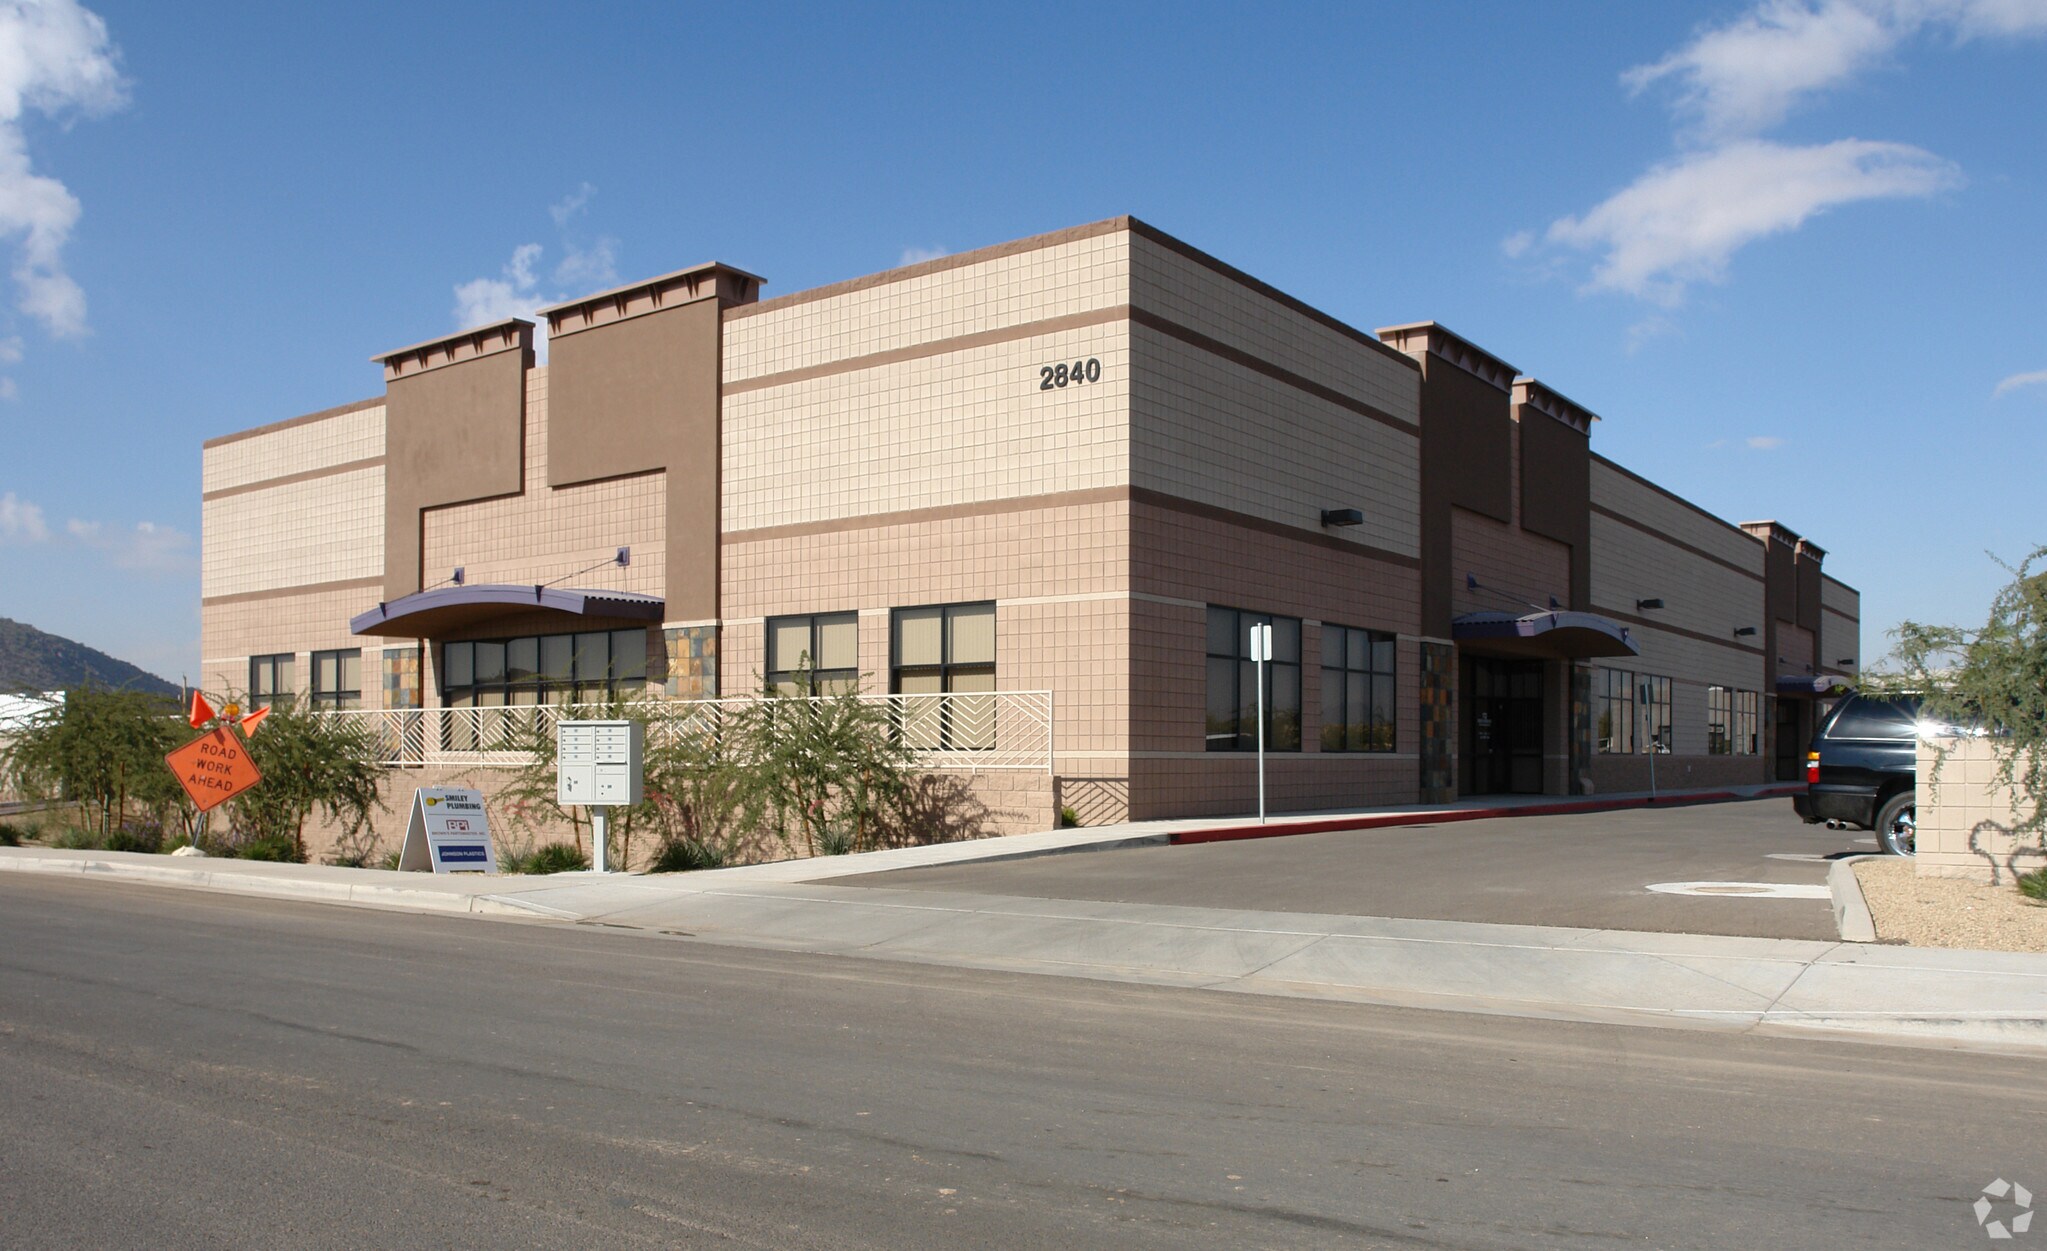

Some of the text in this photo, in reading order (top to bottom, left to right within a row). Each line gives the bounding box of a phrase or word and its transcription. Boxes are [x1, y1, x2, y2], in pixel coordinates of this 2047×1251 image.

[1039, 357, 1101, 391] 2840
[200, 743, 237, 760] ROAD
[196, 758, 233, 775] WORK
[188, 774, 233, 792] AHEAD
[446, 802, 481, 810] PLUMBING
